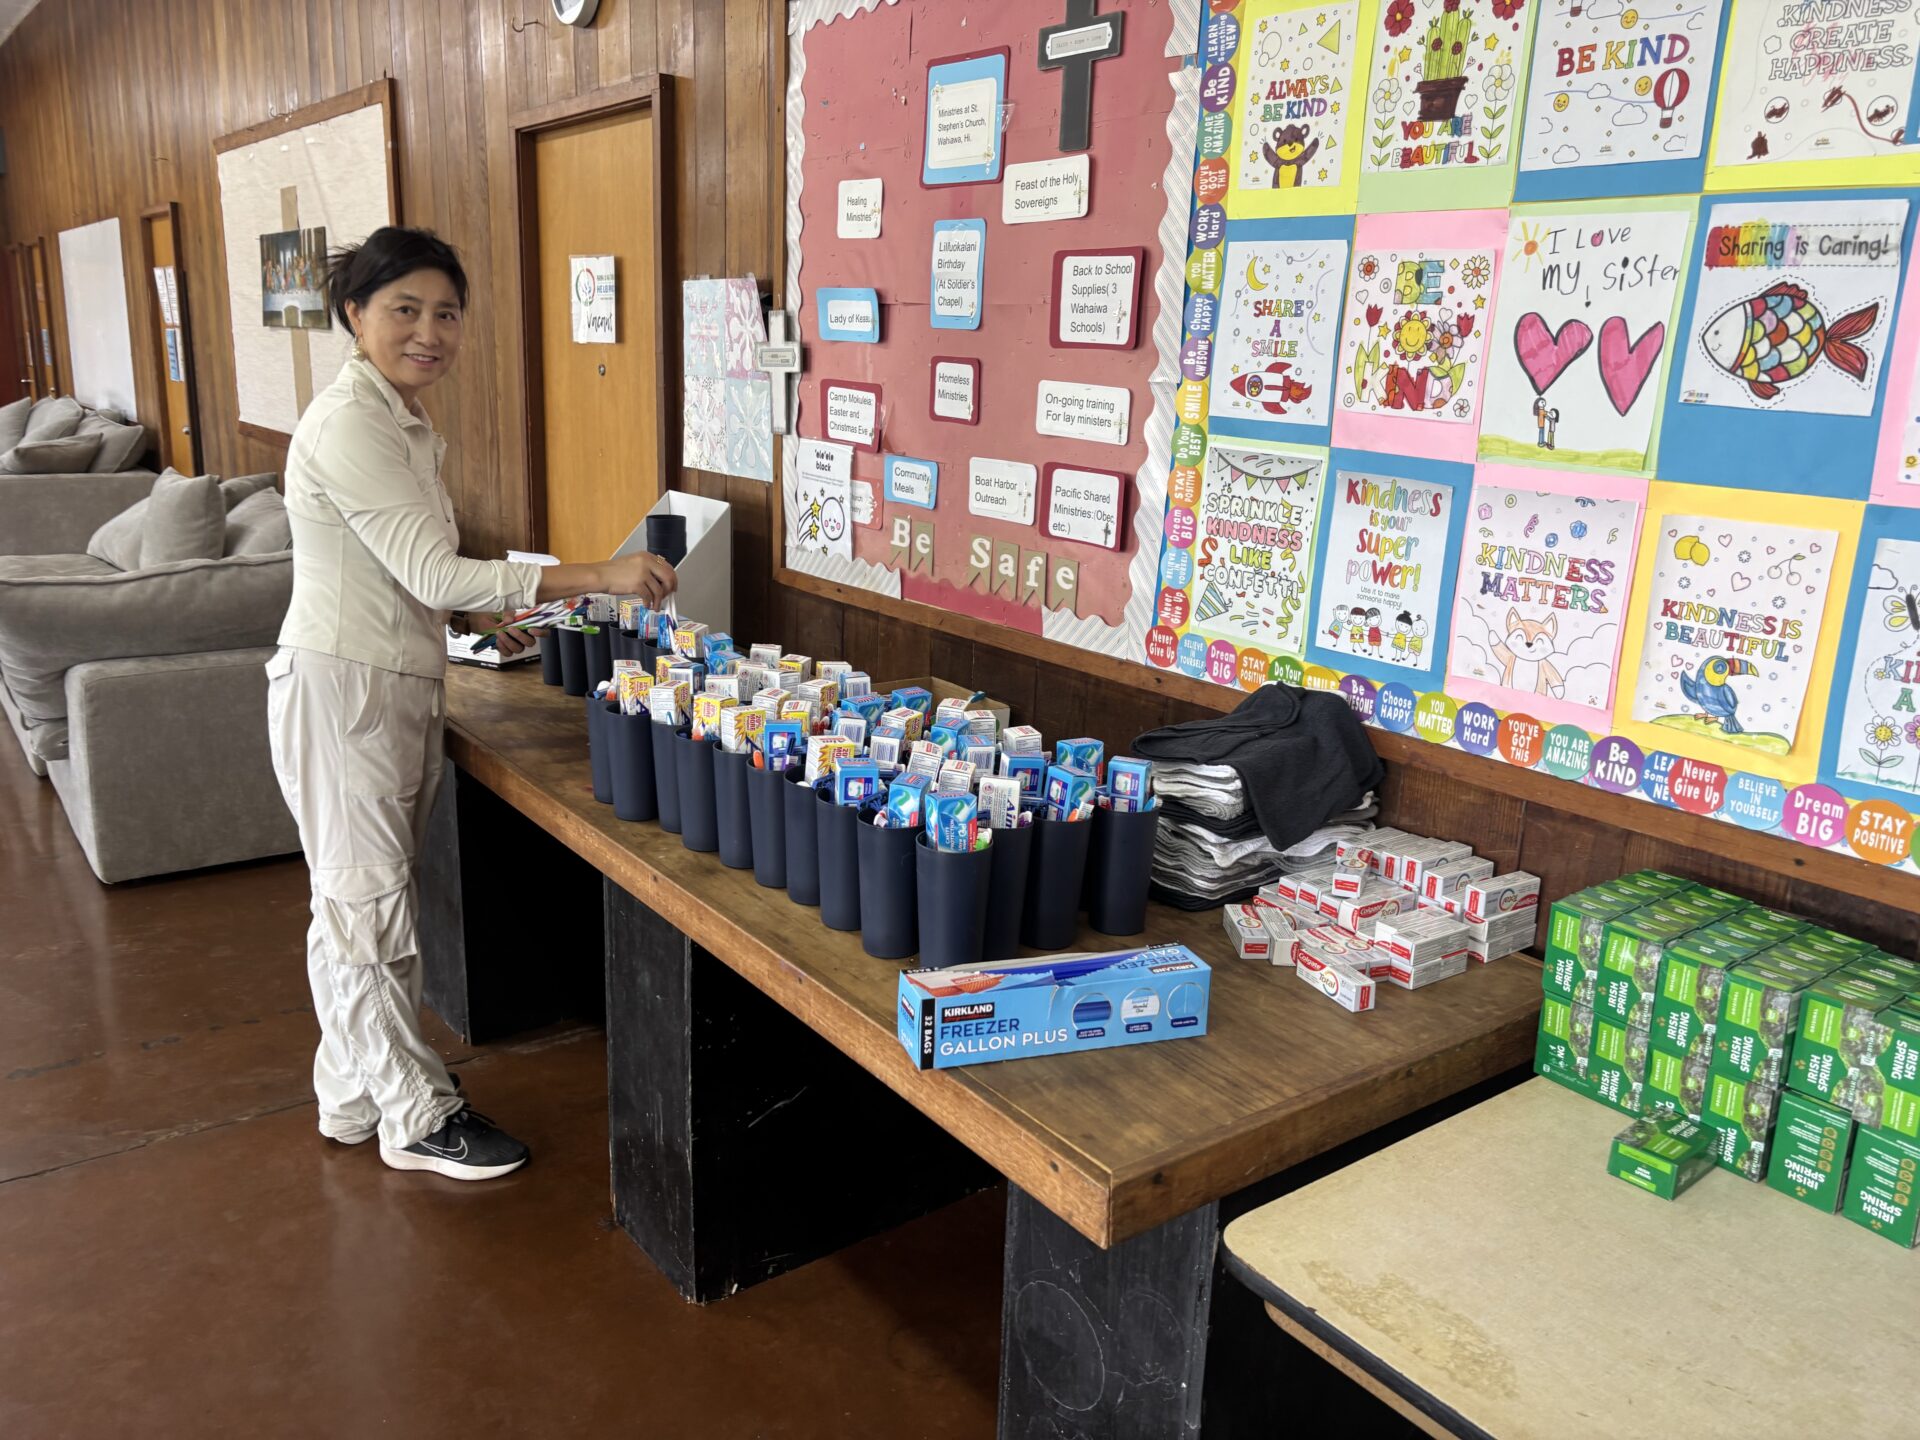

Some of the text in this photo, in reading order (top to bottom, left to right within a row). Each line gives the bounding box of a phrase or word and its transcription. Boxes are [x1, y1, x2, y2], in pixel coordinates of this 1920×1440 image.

[1790, 20, 1894, 52] CREATE
[1556, 34, 1690, 78] BE KIND
[1266, 75, 1330, 100] ALWAYS
[938, 106, 970, 118] Ministries at
[1262, 98, 1328, 122] BE KIND
[938, 118, 986, 132] Stephen's Church,
[1401, 114, 1473, 140] YOU ARE
[1391, 140, 1480, 168] BEAUTIFUL
[1016, 172, 1079, 191] Feast of the Holy
[846, 196, 868, 208] Healing
[1014, 196, 1058, 210] Sovereigns
[846, 212, 872, 222] Ministries
[1547, 228, 1567, 254] I
[1720, 235, 1890, 261] Sharing is Caring!
[938, 258, 966, 272] Birthday
[1072, 262, 1132, 276] Back to School
[947, 279, 976, 290] Soldier's
[1393, 260, 1446, 305] BE
[1542, 260, 1581, 296] my
[938, 296, 963, 309] Chapel)
[1254, 299, 1304, 318] SHARE
[830, 314, 854, 325] Lady of
[1070, 322, 1106, 334] Schools)
[1270, 320, 1282, 338] A
[1252, 340, 1298, 358] SMILE
[938, 372, 970, 386] Homeless
[830, 392, 848, 404] Camp
[938, 388, 968, 402] Ministries
[1046, 393, 1115, 413] On-going training
[830, 406, 860, 418] Easter and
[1046, 410, 1112, 428] For lay ministers
[830, 421, 868, 435] Christmas Eve
[894, 466, 930, 483] Community
[975, 476, 1018, 492] Boat Harbor
[894, 482, 915, 495] Meals
[974, 492, 1007, 506] Outreach
[1055, 486, 1110, 504] Pacific Shared
[1346, 478, 1442, 518] Kindness
[1206, 494, 1302, 526] SPRINKLE
[1369, 510, 1380, 526] is
[890, 518, 931, 554] Be
[1206, 517, 1303, 551] KINDNESS
[970, 538, 1074, 590] Safe
[1230, 546, 1272, 570] LIKE
[1480, 543, 1616, 586] KINDNESS
[1203, 564, 1300, 600] CONFETTI
[1480, 572, 1608, 614] MATTERS
[1660, 598, 1802, 640] KINDNESS IS
[1152, 628, 1174, 644] Never
[1184, 639, 1204, 652] BELIEVE
[1664, 621, 1790, 662] BEAUTIFUL
[1150, 642, 1176, 664] Give Up
[1180, 656, 1205, 670] YOURSELF
[1210, 646, 1236, 663] Dream
[1242, 656, 1266, 670] STAY
[1212, 662, 1232, 680] BIG
[1240, 669, 1266, 684] POSITIVE
[1274, 662, 1302, 683] Do Your
[1352, 679, 1365, 696] Be
[1382, 690, 1412, 710] Choose
[1430, 699, 1445, 714] YOU
[1380, 706, 1411, 724] HAPPY
[1417, 712, 1452, 736] MATTER
[1463, 710, 1494, 731] WORK
[1463, 727, 1490, 747] Hard
[1508, 719, 1538, 738] YOU'VE
[1512, 735, 1532, 749] GOT
[1550, 732, 1590, 754] YOU ARE
[1609, 742, 1630, 764] Be
[1510, 746, 1530, 762] THIS
[1546, 746, 1588, 770] AMAZING
[1595, 760, 1637, 786] KIND
[1682, 759, 1718, 784] Never
[1674, 778, 1720, 810] Give Up
[1738, 778, 1778, 798] BELIEVE
[1751, 793, 1761, 805] IN
[1730, 800, 1779, 822] YOURSELF
[1794, 790, 1844, 820] Dream
[1796, 813, 1834, 842] BIG
[1859, 810, 1908, 835] STAY
[1852, 828, 1905, 856] POSITIVE
[1118, 954, 1189, 970] FREEZER
[1298, 952, 1322, 970] Colgate
[1318, 973, 1336, 988] Total
[1555, 959, 1565, 986] IRISH
[1562, 959, 1574, 992] SPRING
[1608, 981, 1618, 1008] IRISH
[1616, 981, 1628, 1016] SPRING
[944, 1003, 994, 1018] KIRKLAND
[924, 1015, 934, 1055] 32 BAGS
[940, 1018, 1020, 1040] FREEZER
[1667, 1012, 1680, 1040] IRISH
[1676, 1012, 1690, 1048] SPRING
[940, 1033, 1016, 1056] GALLON
[1022, 1028, 1068, 1046] PLUS
[1730, 1036, 1742, 1065] IRISH
[1740, 1036, 1754, 1074] SPRING
[1890, 1039, 1908, 1080] SPRING
[1904, 1048, 1919, 1080] IRISH
[1807, 1054, 1821, 1084] IRISH
[1818, 1054, 1833, 1092] SPRING
[1600, 1070, 1610, 1096] IRISH
[1609, 1070, 1620, 1102] SPRING
[1724, 1128, 1737, 1164] SPRING
[1784, 1158, 1826, 1184] SPRING
[1788, 1171, 1818, 1190] IRISH
[1860, 1190, 1902, 1217] SPRING
[1862, 1204, 1894, 1225] IRISH
